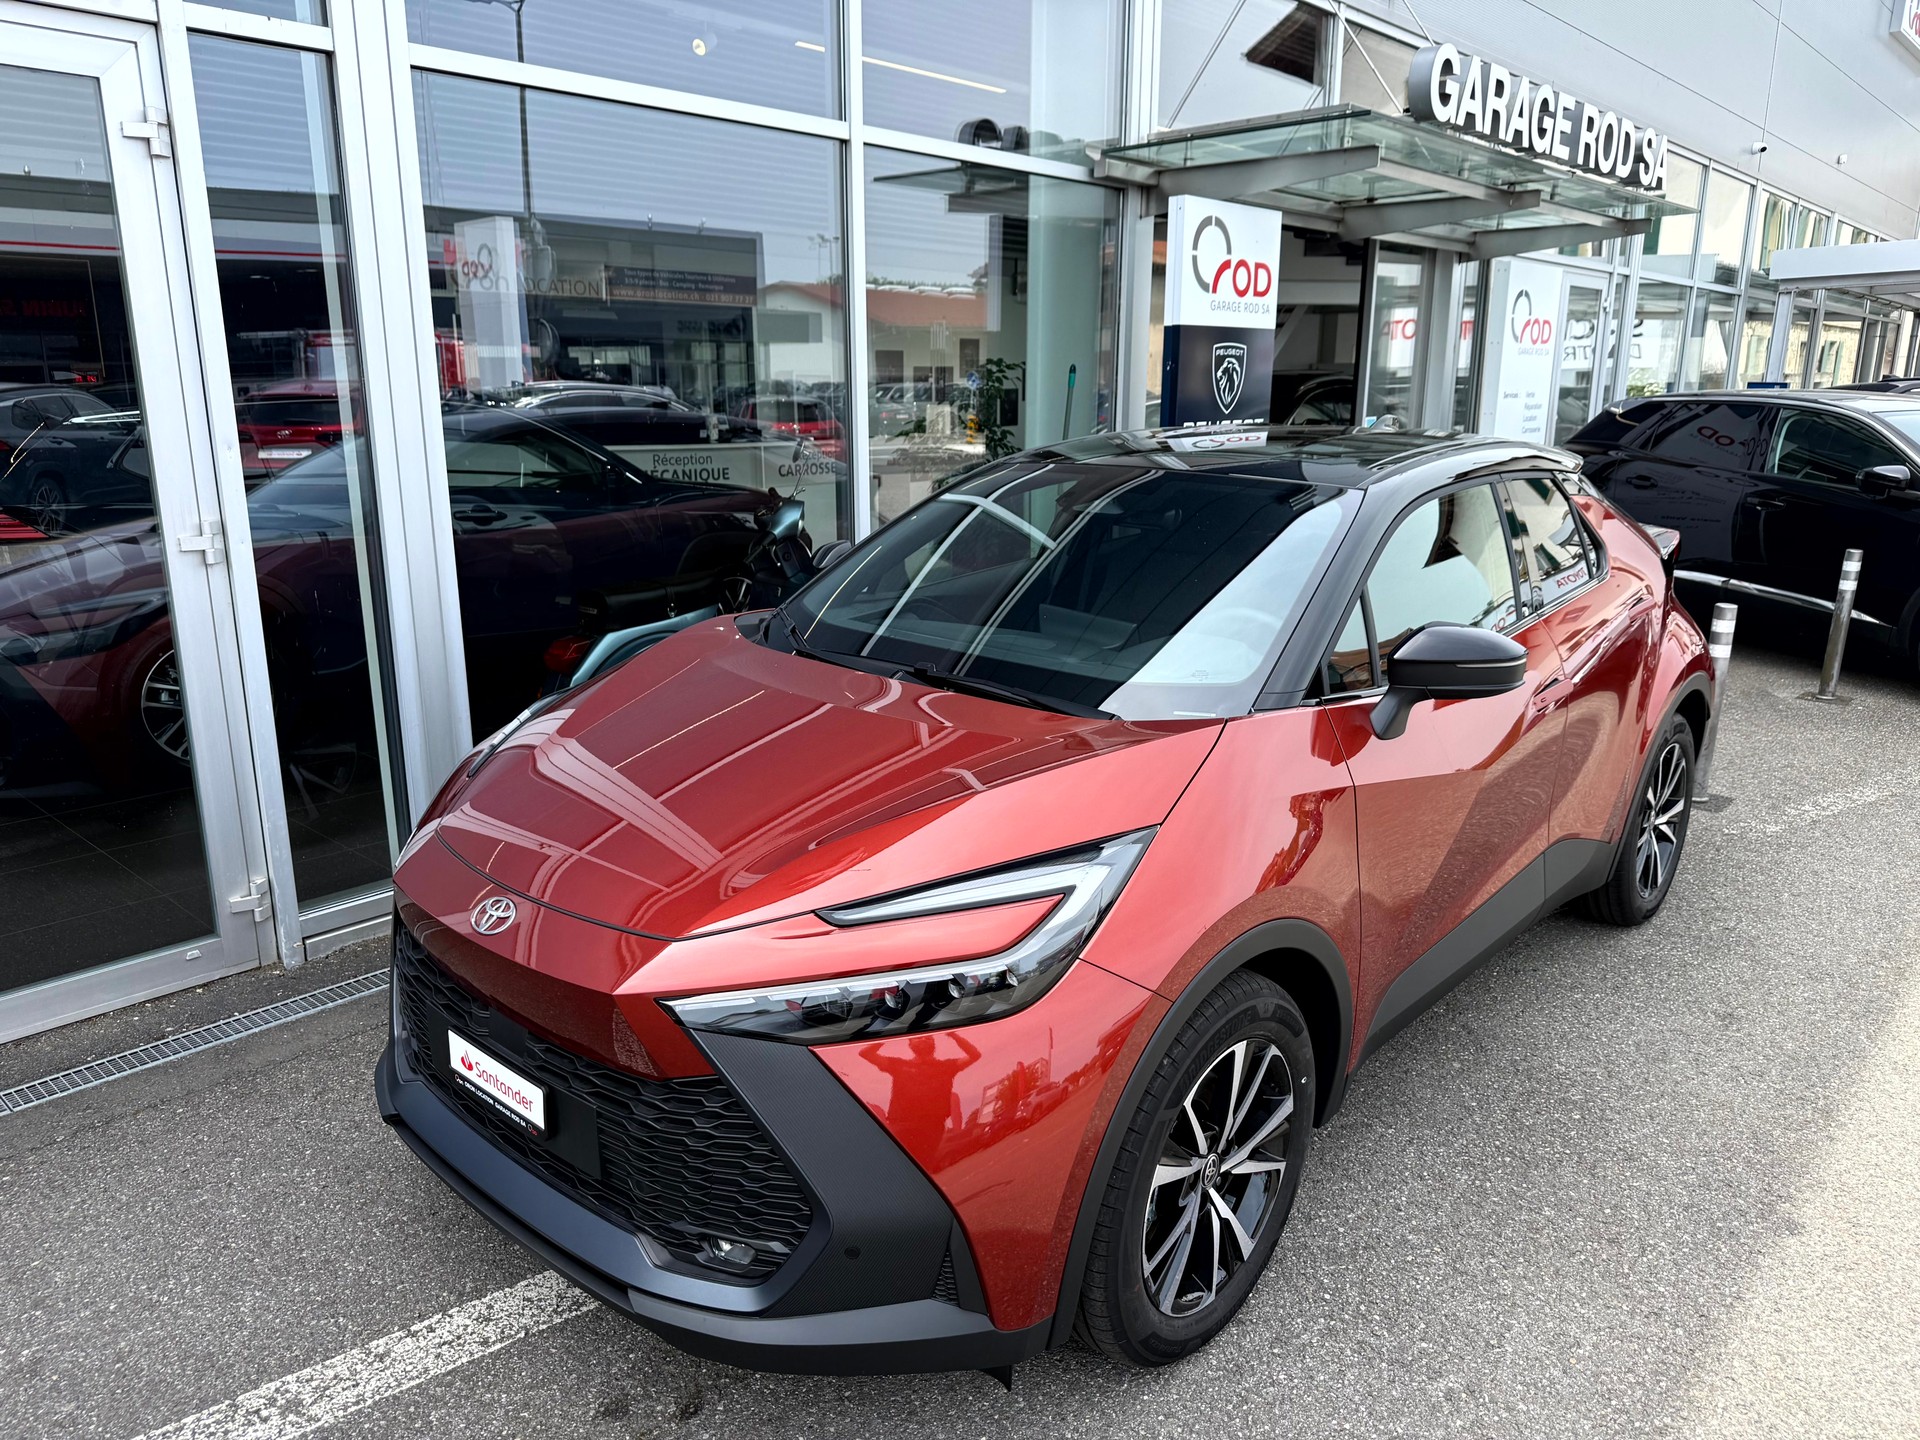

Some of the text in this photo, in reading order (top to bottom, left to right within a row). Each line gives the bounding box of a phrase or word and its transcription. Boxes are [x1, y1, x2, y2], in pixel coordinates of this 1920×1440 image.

[1430, 42, 1668, 191] GARAGE ROD SA
[520, 275, 599, 296] OCATION
[1210, 299, 1271, 315] GARAGE ROD SA
[1215, 348, 1244, 357] PEUGEOT
[653, 453, 713, 468] Réception
[643, 466, 730, 483] ÉCANIQUE
[475, 1061, 533, 1112] Santander
